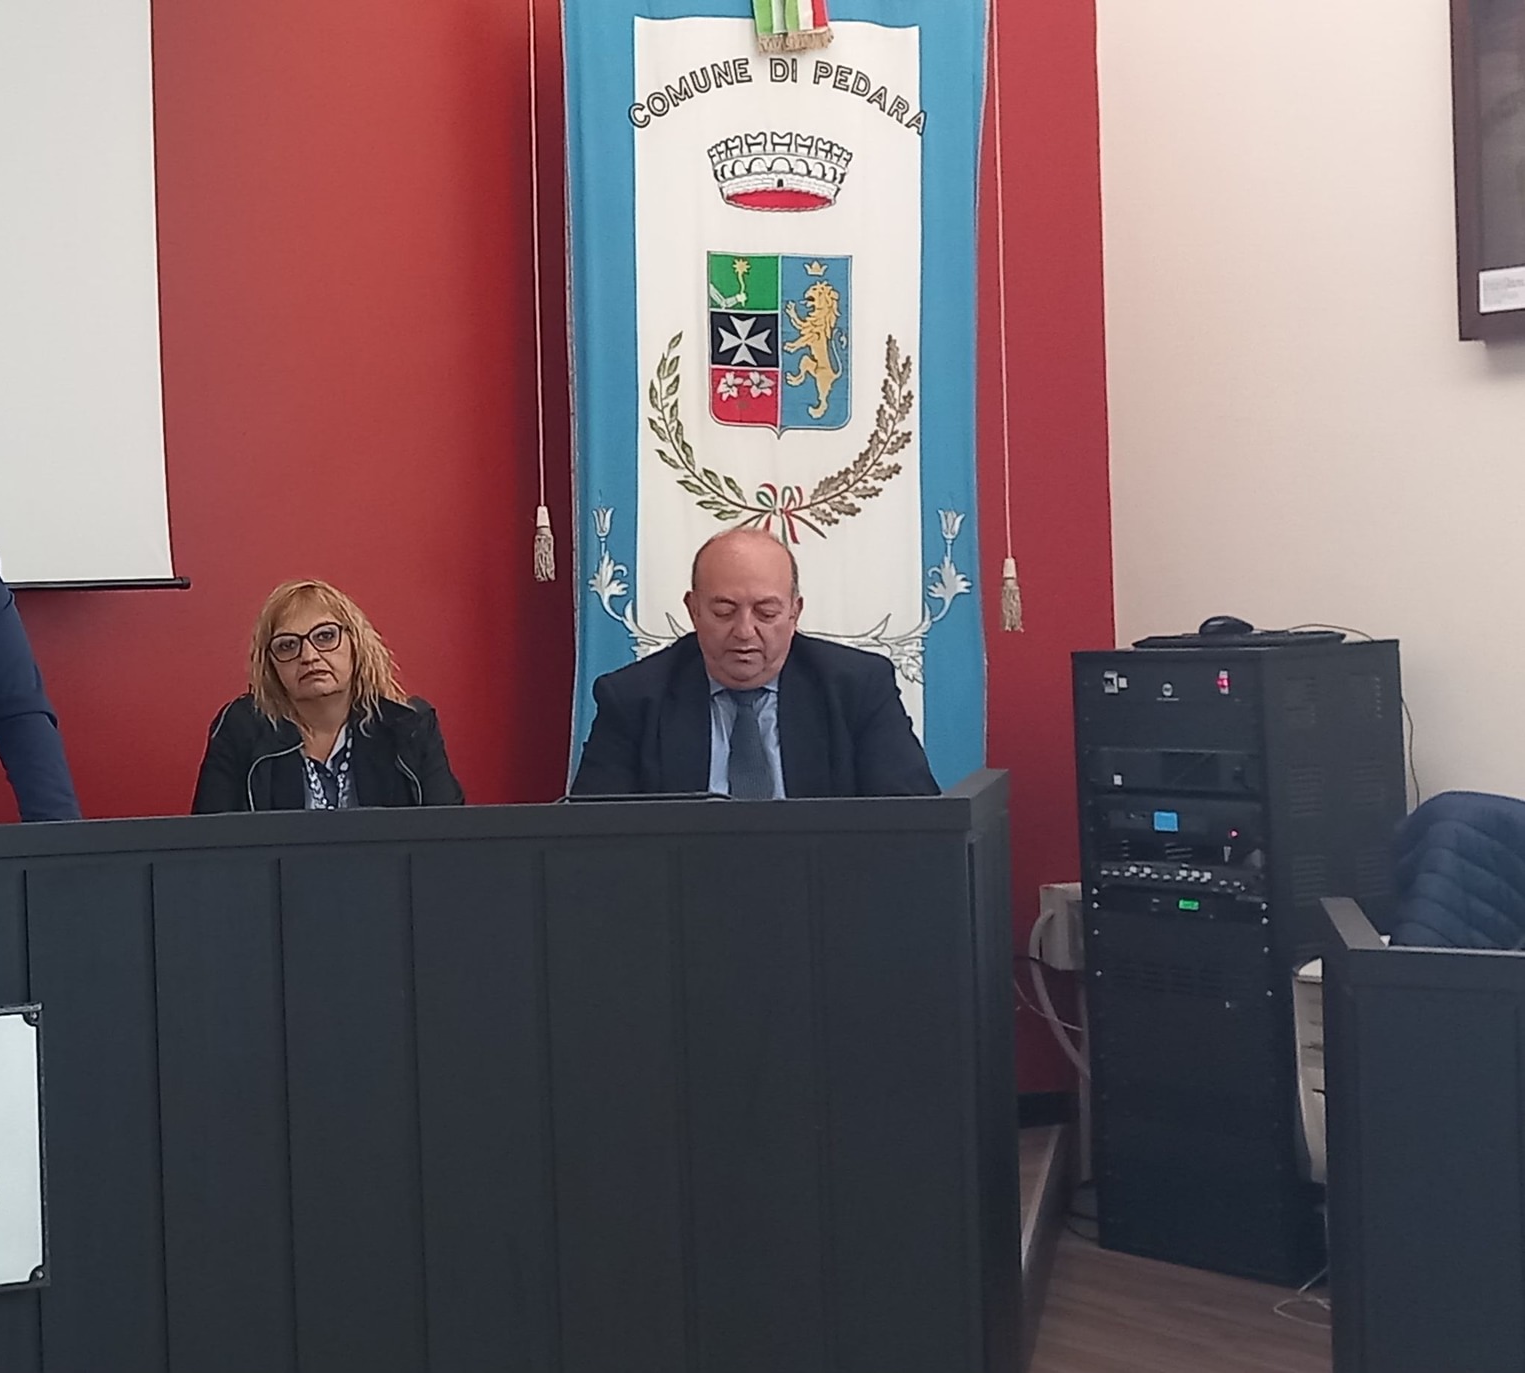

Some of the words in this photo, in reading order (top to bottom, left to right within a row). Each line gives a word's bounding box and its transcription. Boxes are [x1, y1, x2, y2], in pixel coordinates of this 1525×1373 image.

[628, 58, 752, 129] COMUNE
[769, 58, 798, 83] DI
[812, 60, 928, 135] PEDARA
